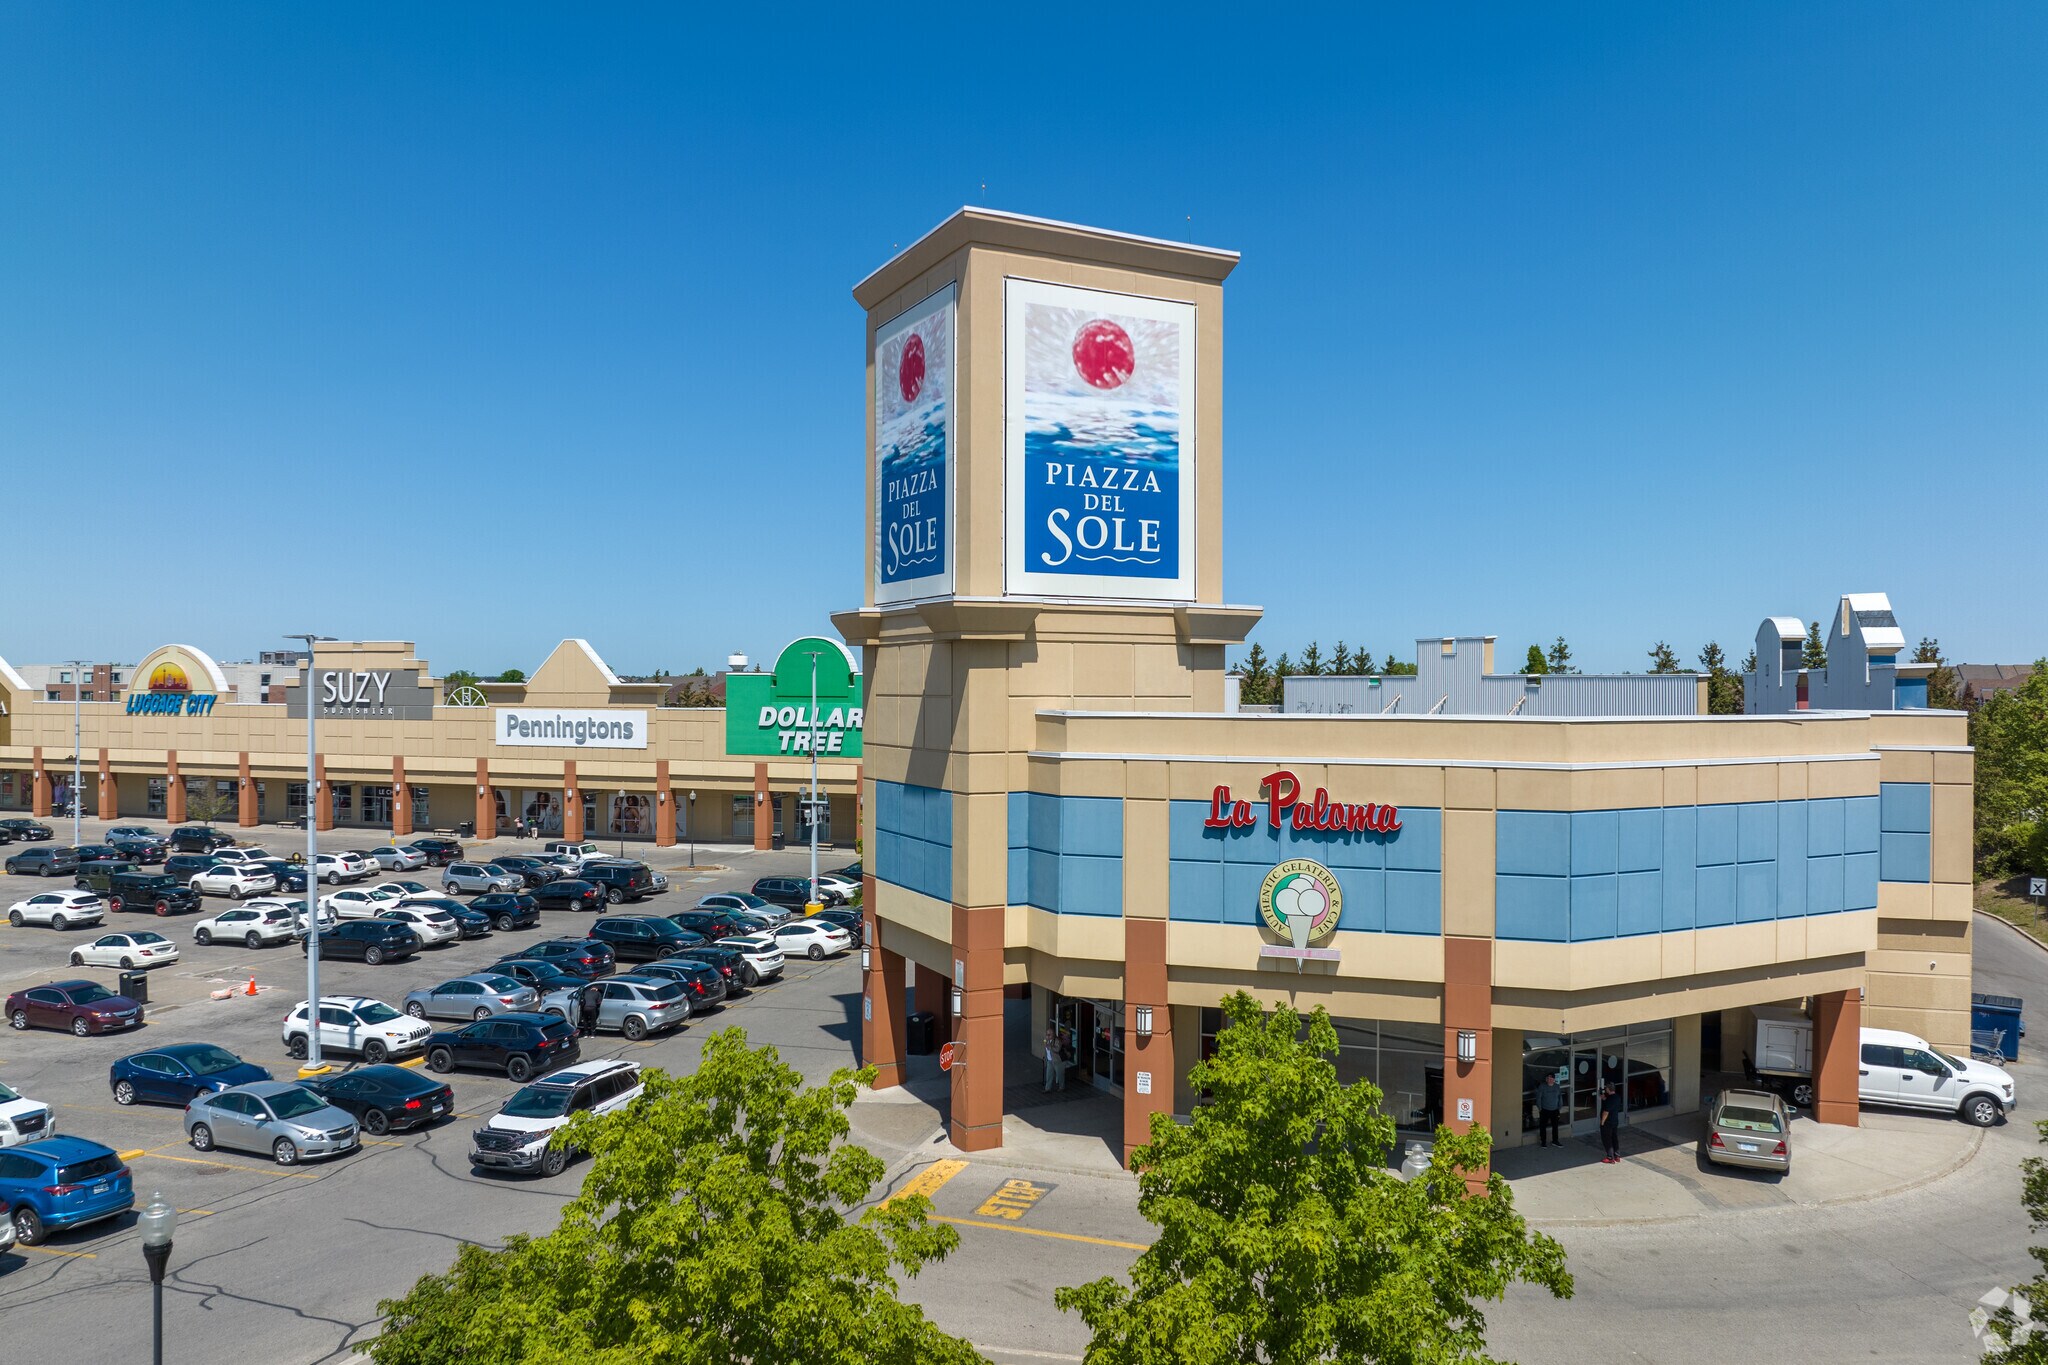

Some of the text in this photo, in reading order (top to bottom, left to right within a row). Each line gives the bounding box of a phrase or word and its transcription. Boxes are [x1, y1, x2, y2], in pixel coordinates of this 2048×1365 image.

[888, 467, 938, 503] PIAZZA
[1045, 462, 1162, 493] PIAZZA
[902, 502, 921, 520] DEL
[1083, 494, 1125, 513] DEL
[886, 516, 937, 576] SOLE
[1041, 508, 1161, 567] SOLE
[322, 671, 391, 703] SUZY
[126, 693, 218, 714] LUGGAGE CITY
[758, 706, 863, 728] DOLLAR
[506, 714, 634, 745] Penningtons
[778, 730, 844, 752] TREE
[1204, 770, 1403, 833] La Paloma
[1261, 870, 1286, 932] AUTHENTIC
[1282, 862, 1337, 894] GELATERIA
[1332, 899, 1340, 907] &
[940, 1050, 953, 1064] STOP
[975, 1179, 1046, 1220] STOP
